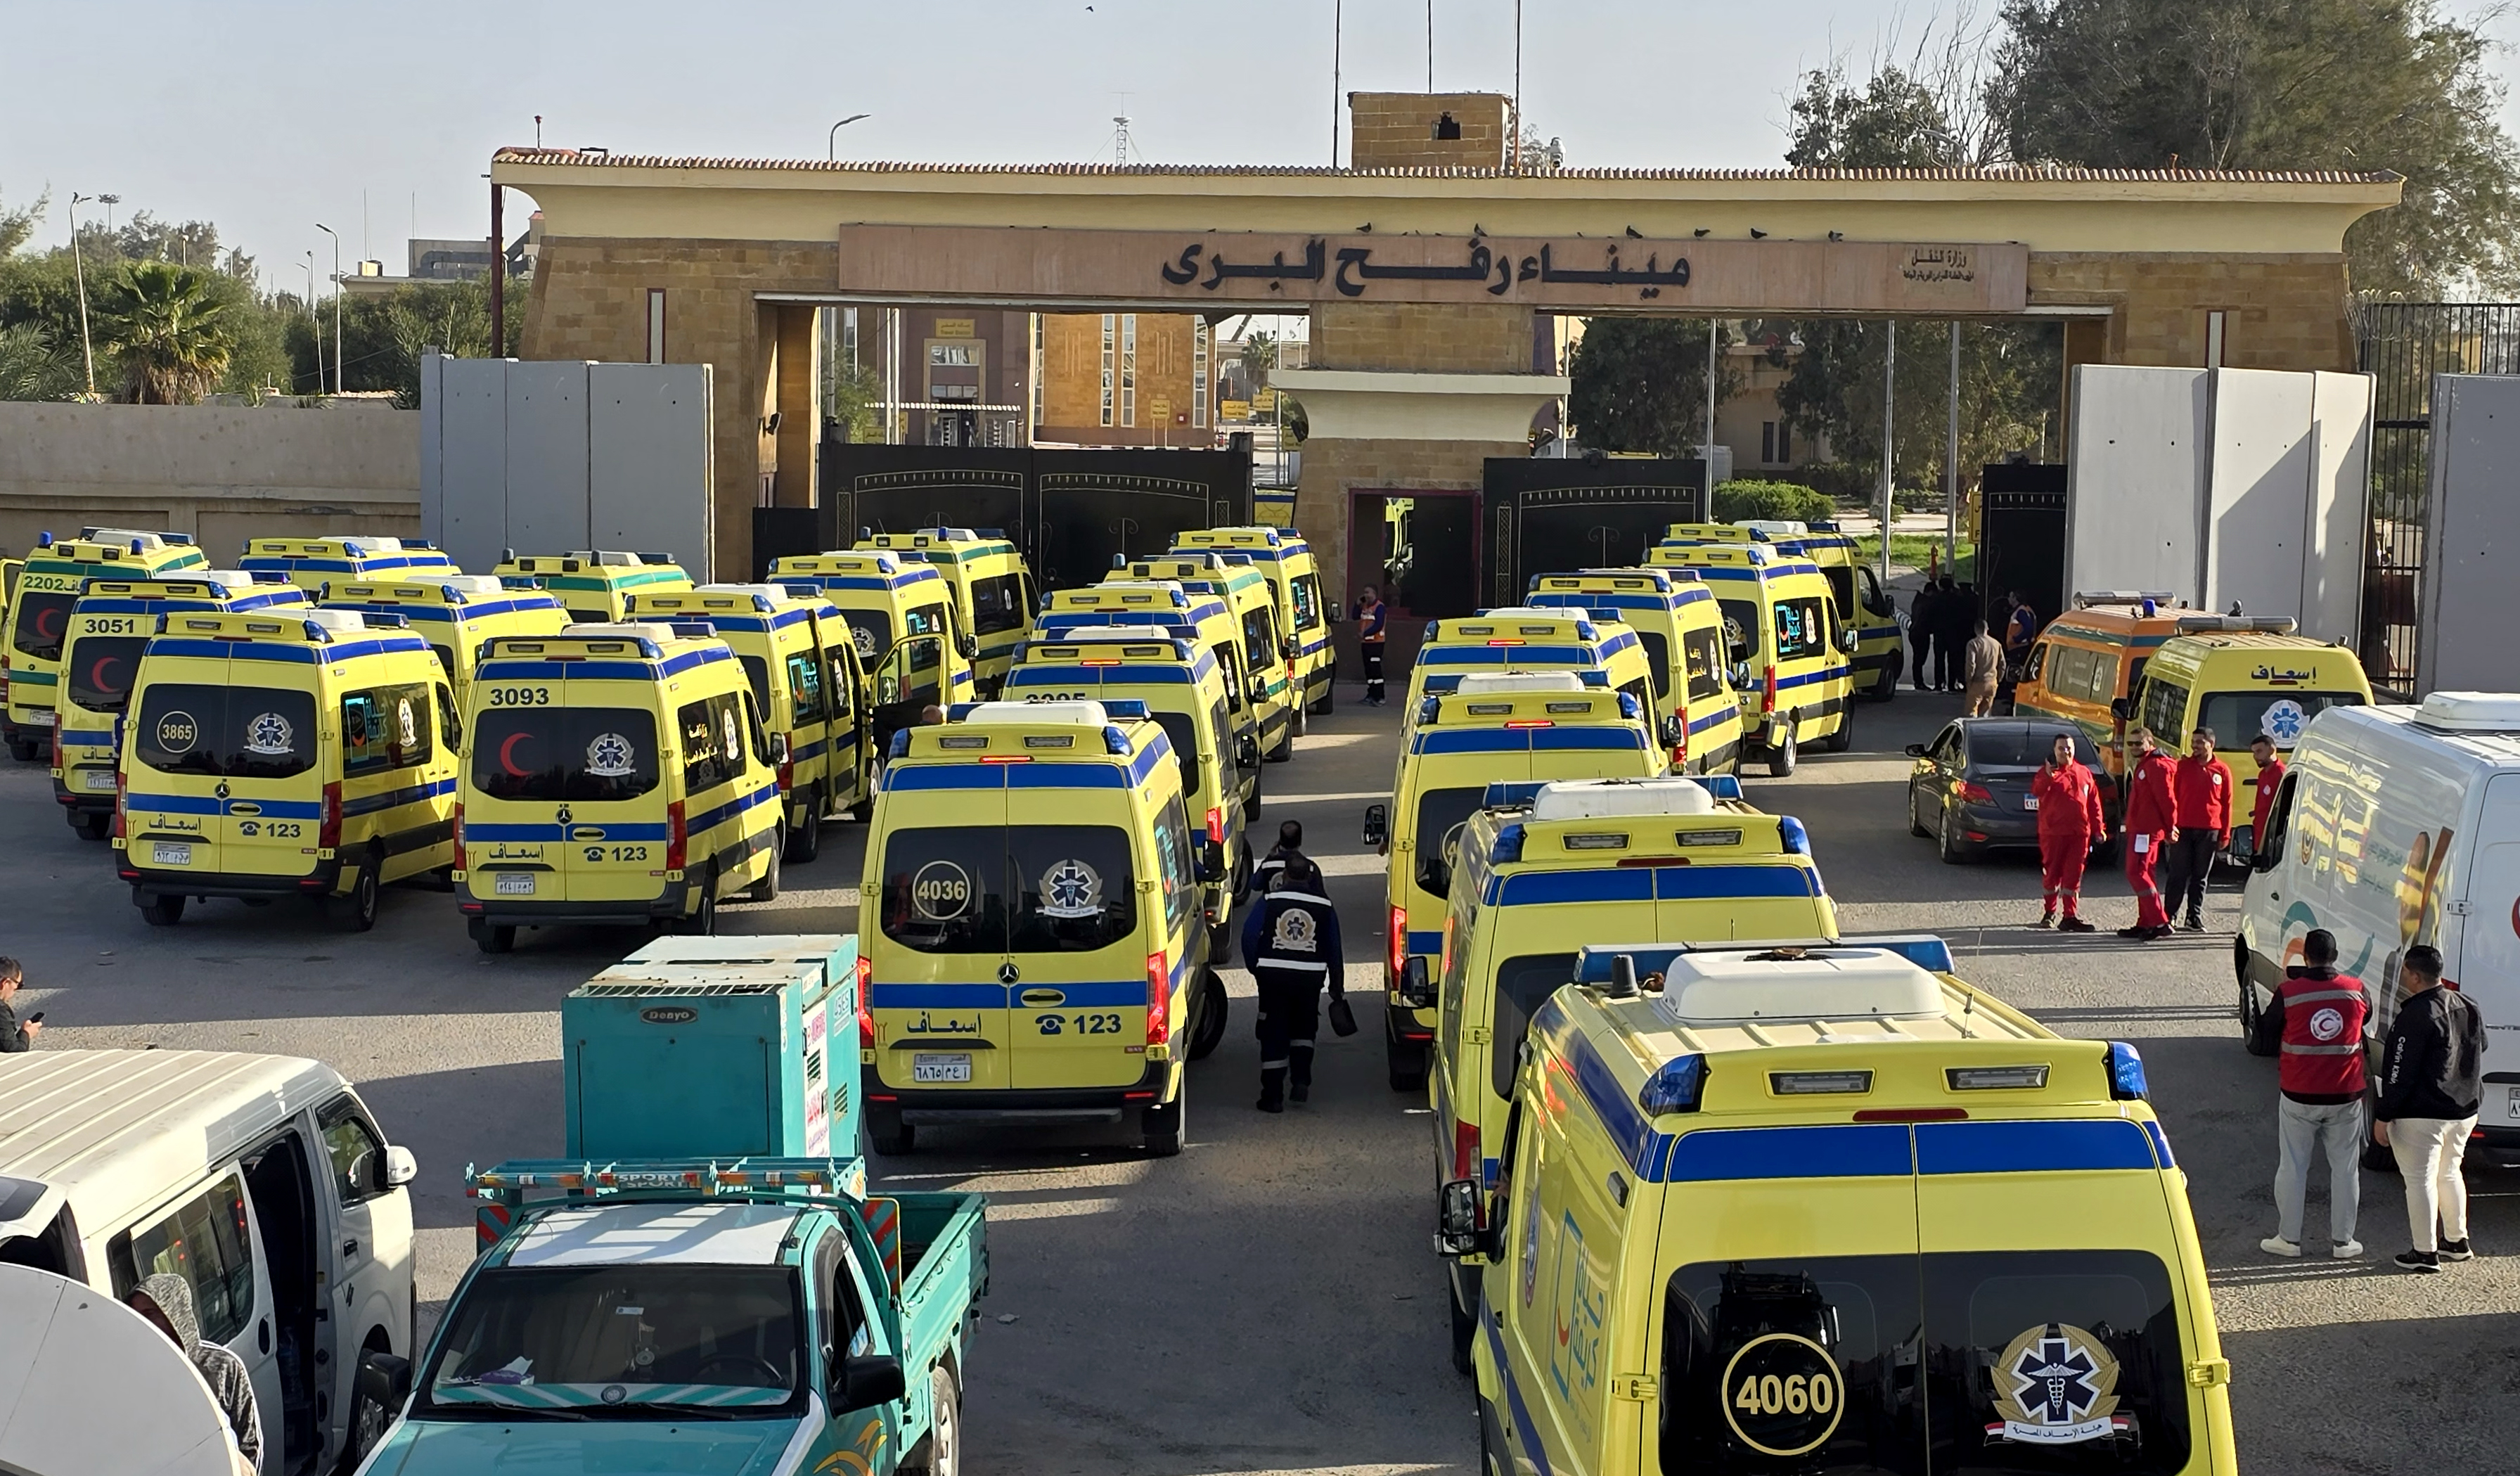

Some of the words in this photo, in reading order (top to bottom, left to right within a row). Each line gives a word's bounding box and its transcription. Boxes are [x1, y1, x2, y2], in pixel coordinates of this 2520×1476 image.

[1335, 238, 1512, 296] رفح
[1518, 243, 1690, 300] ميناء
[23, 576, 64, 591] 2202
[84, 619, 134, 634] 3051
[489, 688, 550, 706] 3093
[162, 724, 193, 740] 3865
[148, 813, 202, 835] إسعاف
[266, 823, 302, 838] 123
[489, 842, 544, 863] إسعاف
[611, 847, 648, 862] 123
[917, 880, 966, 901] 4036
[906, 1010, 982, 1038] إسعاف
[1073, 1013, 1122, 1035] 123
[1736, 1373, 1833, 1415] 4060
[2080, 1423, 2103, 1433] هيئة
